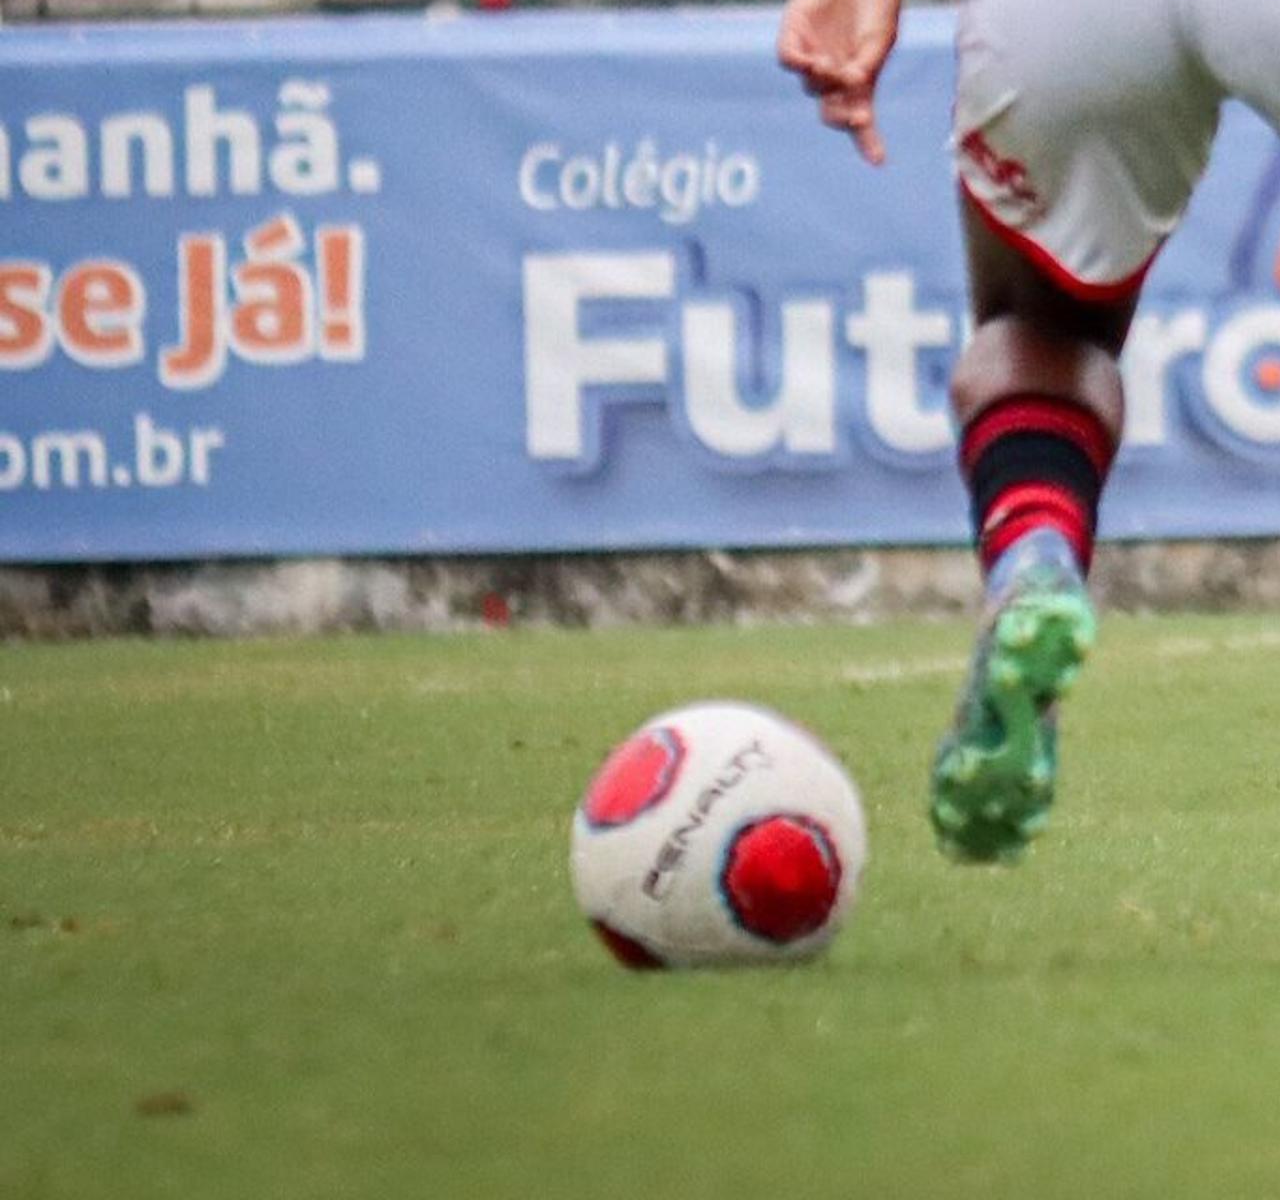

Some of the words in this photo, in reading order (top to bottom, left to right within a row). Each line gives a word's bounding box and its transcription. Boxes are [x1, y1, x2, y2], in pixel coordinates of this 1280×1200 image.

[0, 78, 382, 199] anhã.
[519, 138, 760, 223] Colégio
[158, 211, 366, 391] Já!
[642, 739, 773, 901] PENALTY
